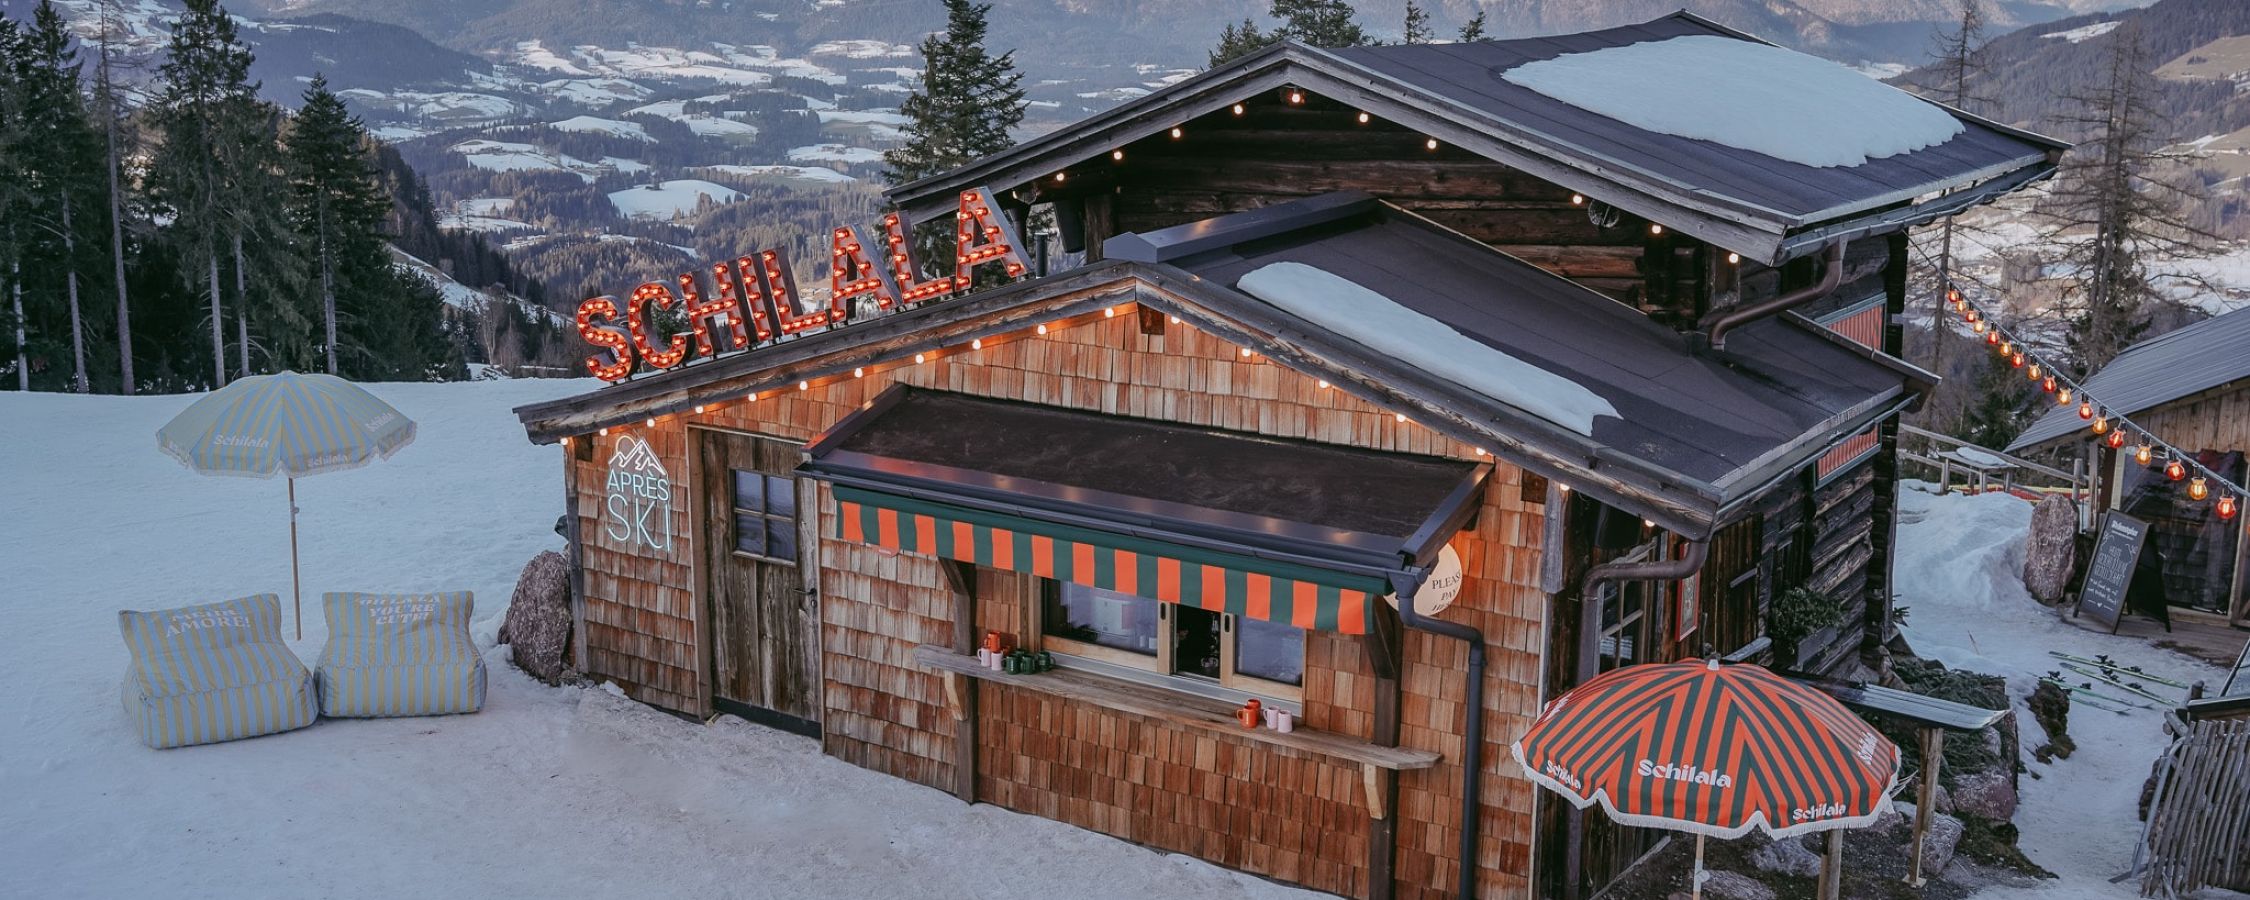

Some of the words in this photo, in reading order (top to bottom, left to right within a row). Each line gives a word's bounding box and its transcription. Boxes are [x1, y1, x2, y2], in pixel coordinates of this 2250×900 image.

[577, 186, 1032, 382] SCHILALA
[213, 434, 269, 448] Schilala
[607, 469, 669, 501] APRÈS
[608, 493, 671, 553] SKI
[166, 616, 250, 637] AMORE!
[1638, 758, 1732, 788] Schilala
